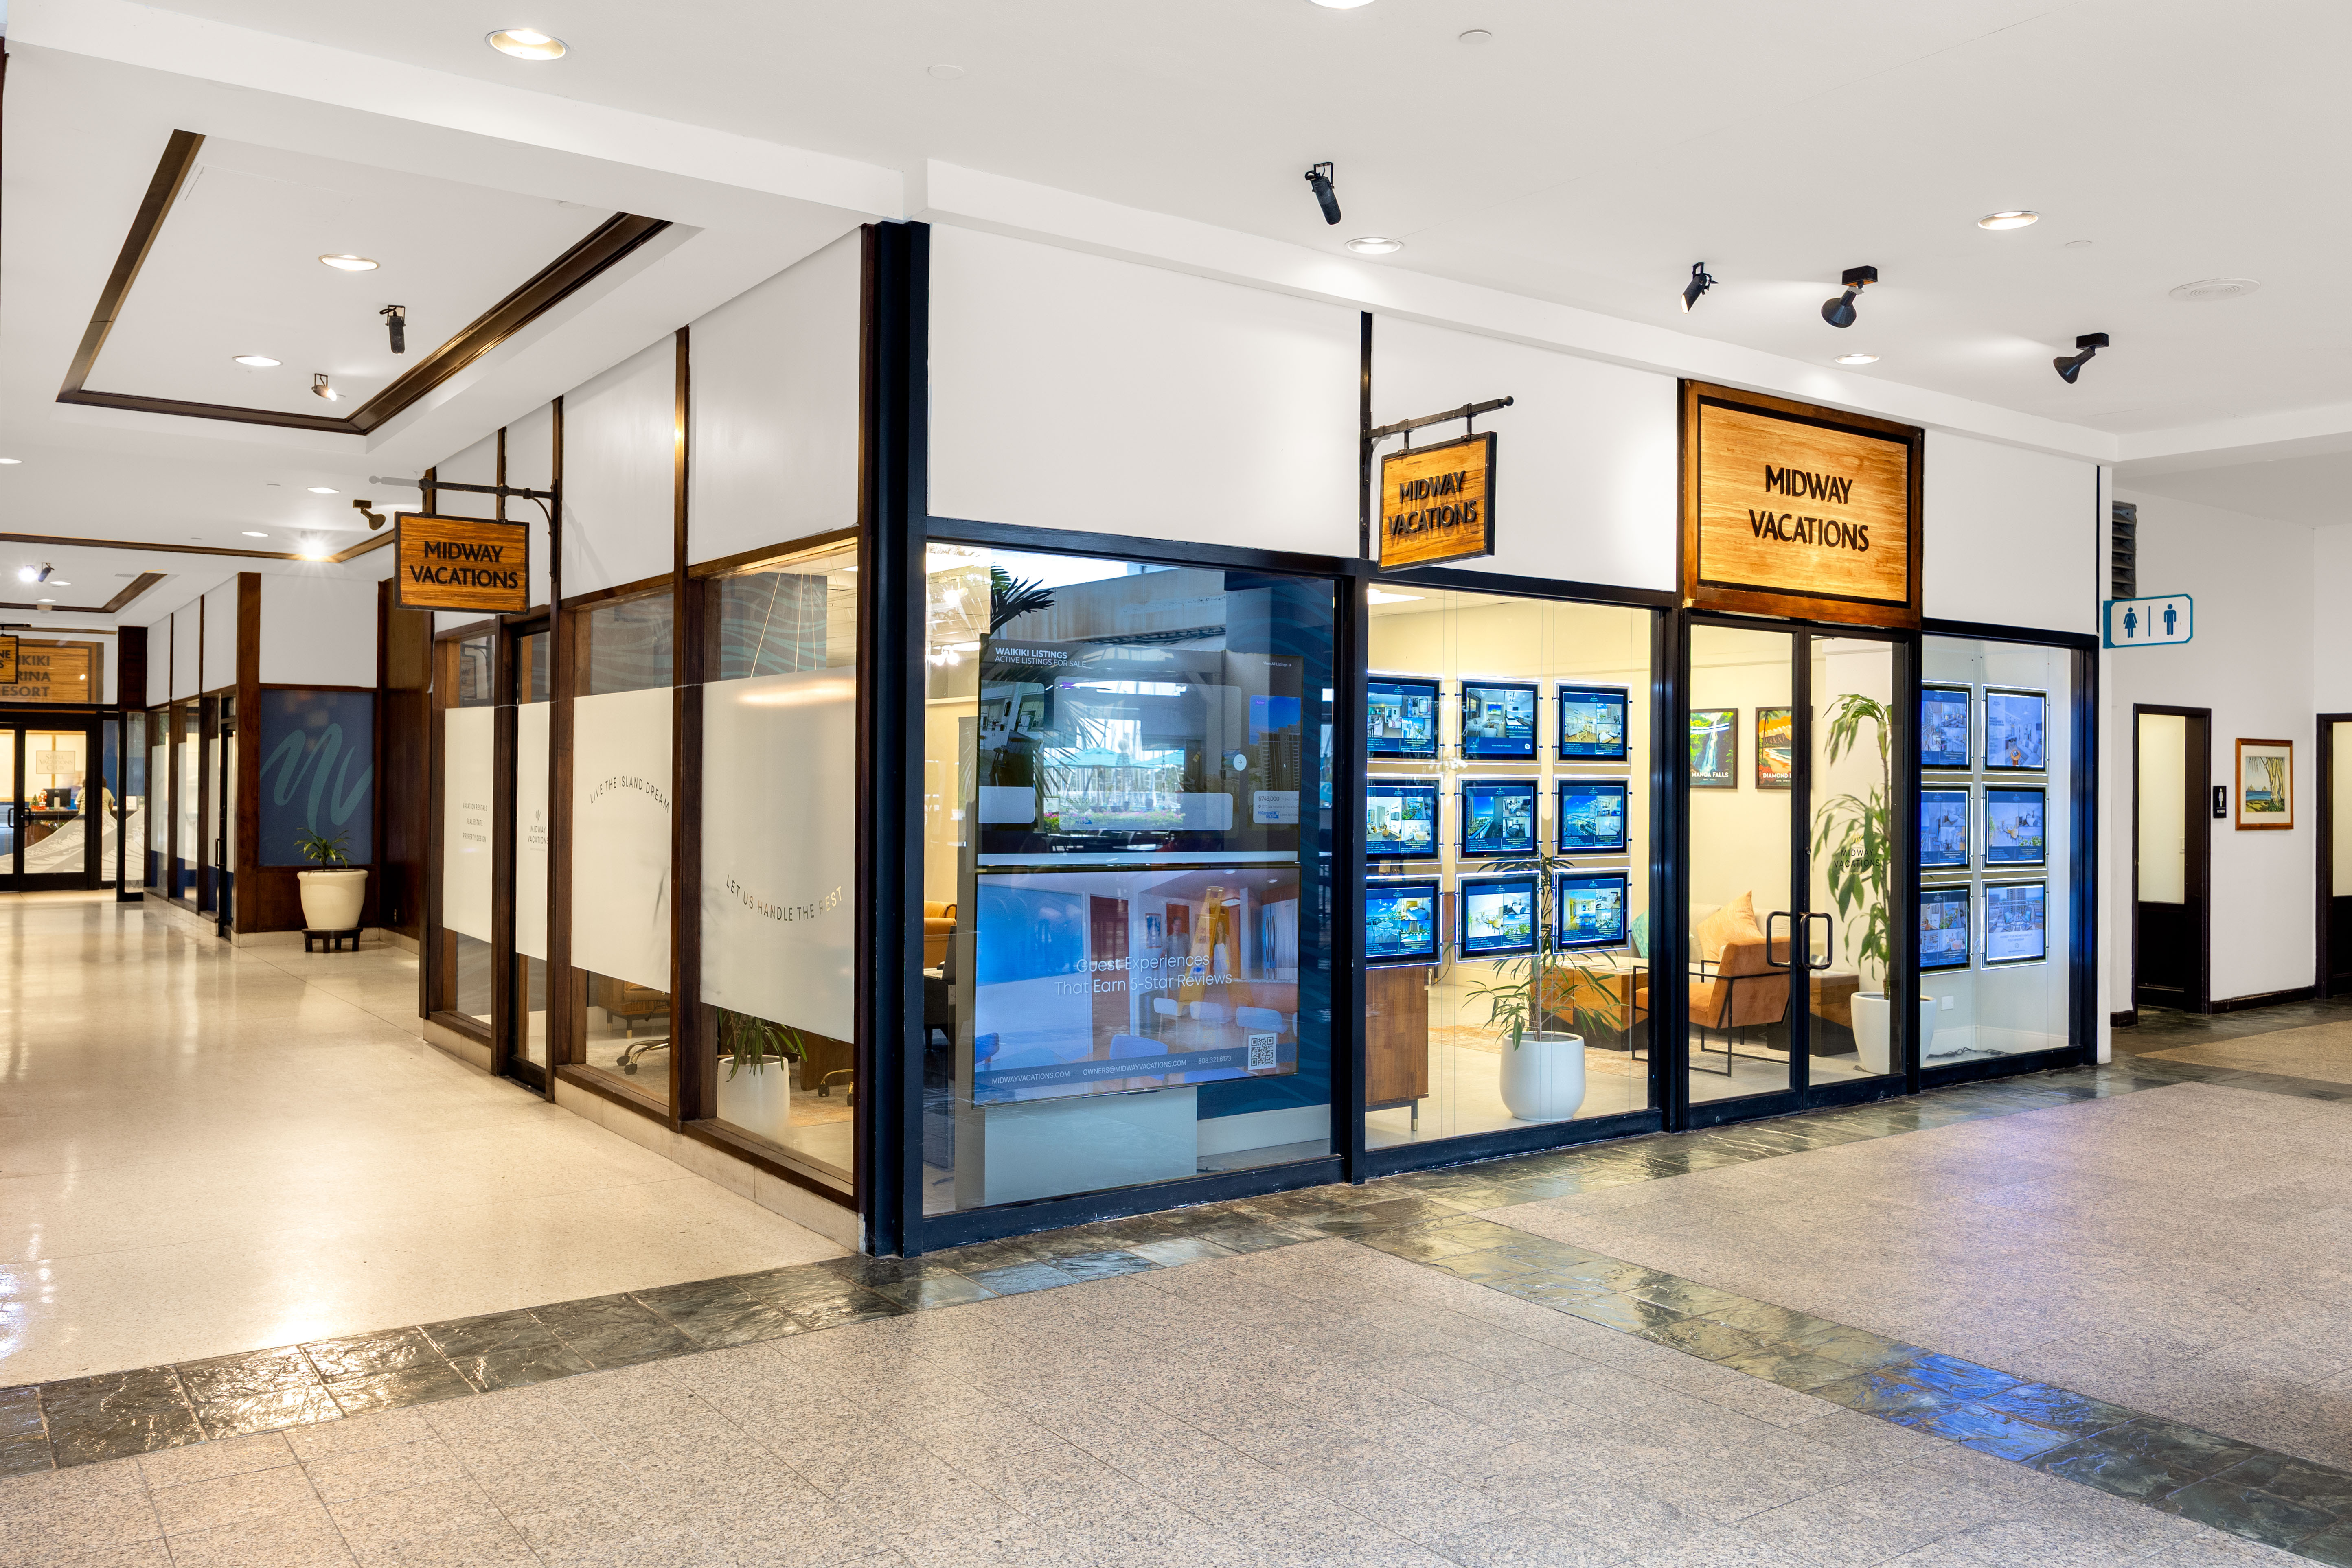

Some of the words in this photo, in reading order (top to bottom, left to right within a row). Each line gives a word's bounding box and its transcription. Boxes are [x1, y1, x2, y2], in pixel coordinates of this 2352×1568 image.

[1399, 470, 1466, 503] MIDWAY
[1765, 464, 1853, 504] MIDWAY
[1388, 500, 1477, 536] VACATIONS
[1749, 509, 1869, 552] VACATIONS
[424, 541, 504, 563] MIDWAY
[410, 565, 518, 589] VACATIONS
[19, 655, 50, 666] IKIKI
[995, 647, 1029, 657] WAIKIKI
[1032, 650, 1067, 659] LISTINGS
[1021, 657, 1052, 666] LISTINGS
[18, 671, 51, 682] RINA
[2, 685, 50, 697] ESORT
[590, 784, 603, 804] LIVE
[605, 777, 616, 792] THE
[619, 775, 643, 790] ISLAND
[646, 782, 669, 813] DREAM
[530, 825, 546, 834] MIDWAY
[1834, 859, 1880, 867] VACATIONS
[1841, 849, 1874, 857] MIDWAY
[726, 874, 740, 898] LET
[743, 891, 754, 909] US
[757, 900, 793, 921] HANDLE
[797, 904, 814, 920] THE
[819, 885, 842, 915] REST
[1076, 958, 1120, 972] Guest
[1125, 954, 1210, 972] Experiences
[1054, 981, 1089, 996] That
[1094, 979, 1126, 993] Earn
[1131, 976, 1174, 990] 5-Star
[1177, 973, 1233, 988] Reviews
[991, 1070, 1070, 1084] MIDWAYVACATIONS.COM
[1083, 1059, 1187, 1076] OWNERS@MIDWAYVACATIONS.COM
[1198, 1056, 1232, 1064] 808.321.6173
